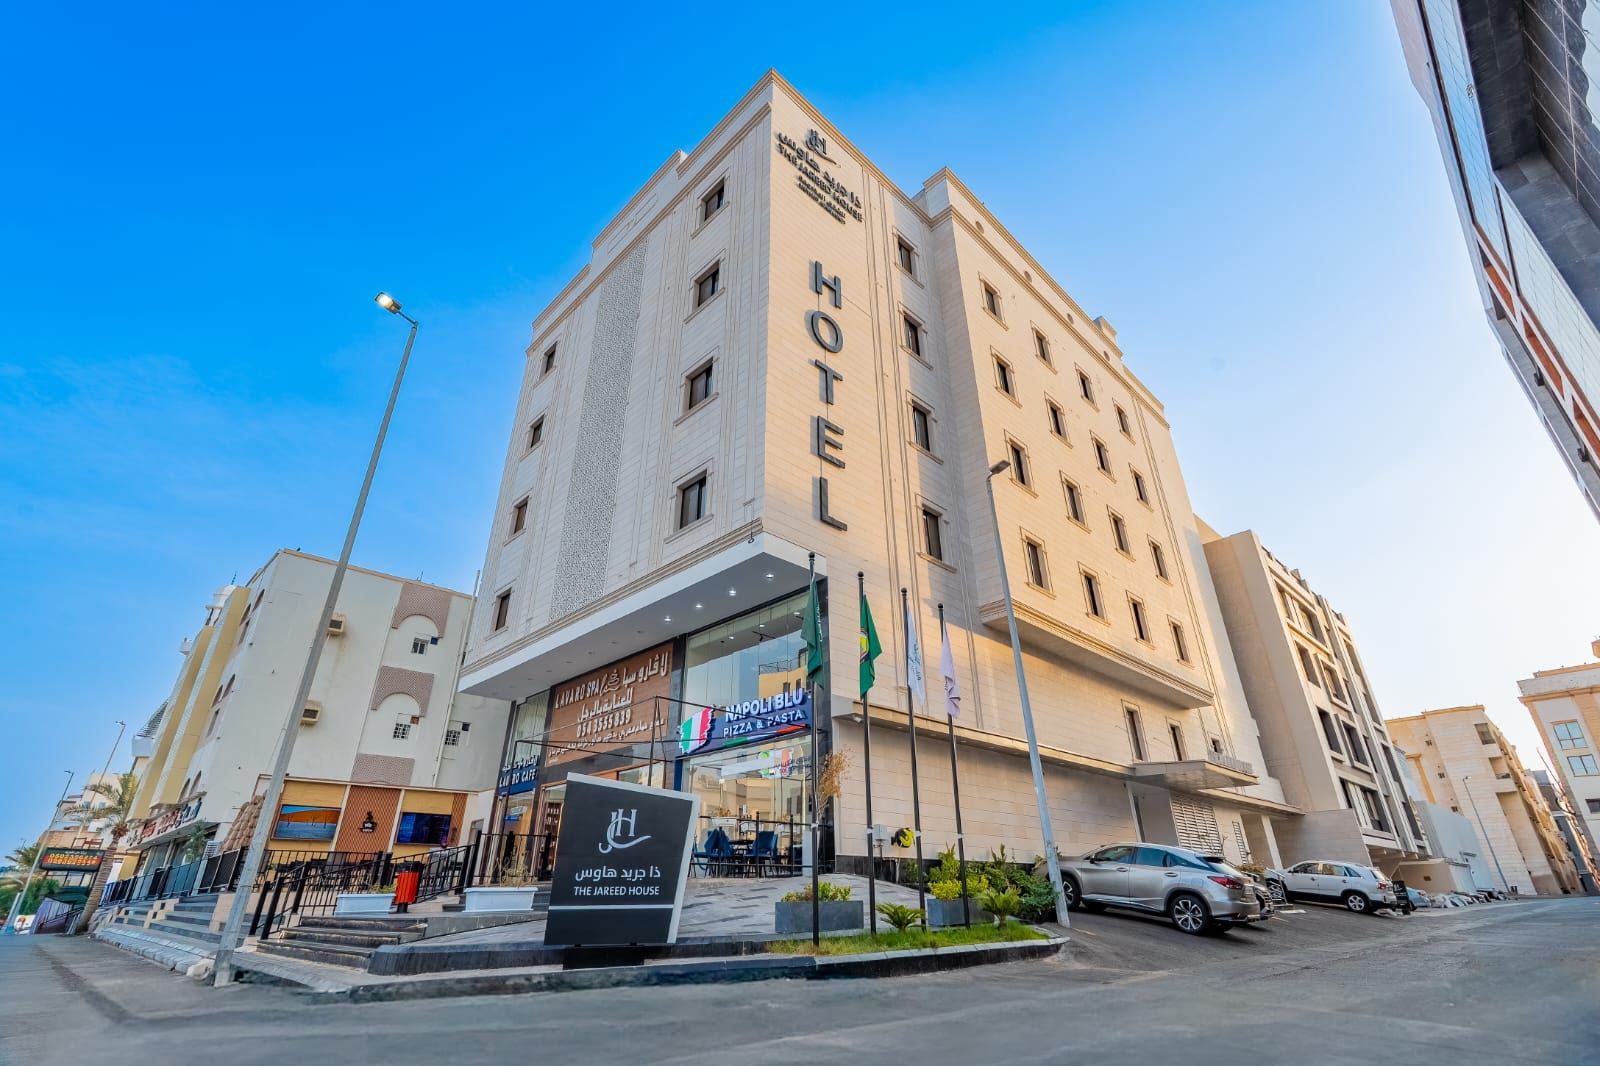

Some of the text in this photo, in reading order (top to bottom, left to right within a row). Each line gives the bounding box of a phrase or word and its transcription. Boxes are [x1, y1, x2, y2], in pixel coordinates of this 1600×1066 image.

[777, 143, 798, 166] THE
[798, 162, 832, 195] JAREED
[832, 191, 863, 222] HOUSE
[810, 260, 848, 532] HOTEL
[622, 667, 637, 688] سبا
[554, 679, 601, 709] LAVARO SPA
[724, 688, 803, 722] NAPOLI BLU
[723, 709, 803, 737] PIZZA & PASTA
[499, 768, 536, 788] LAVRO CAFE
[575, 865, 661, 882] ذا جريد هاوس
[573, 886, 660, 896] THE JAREED HOUSE
